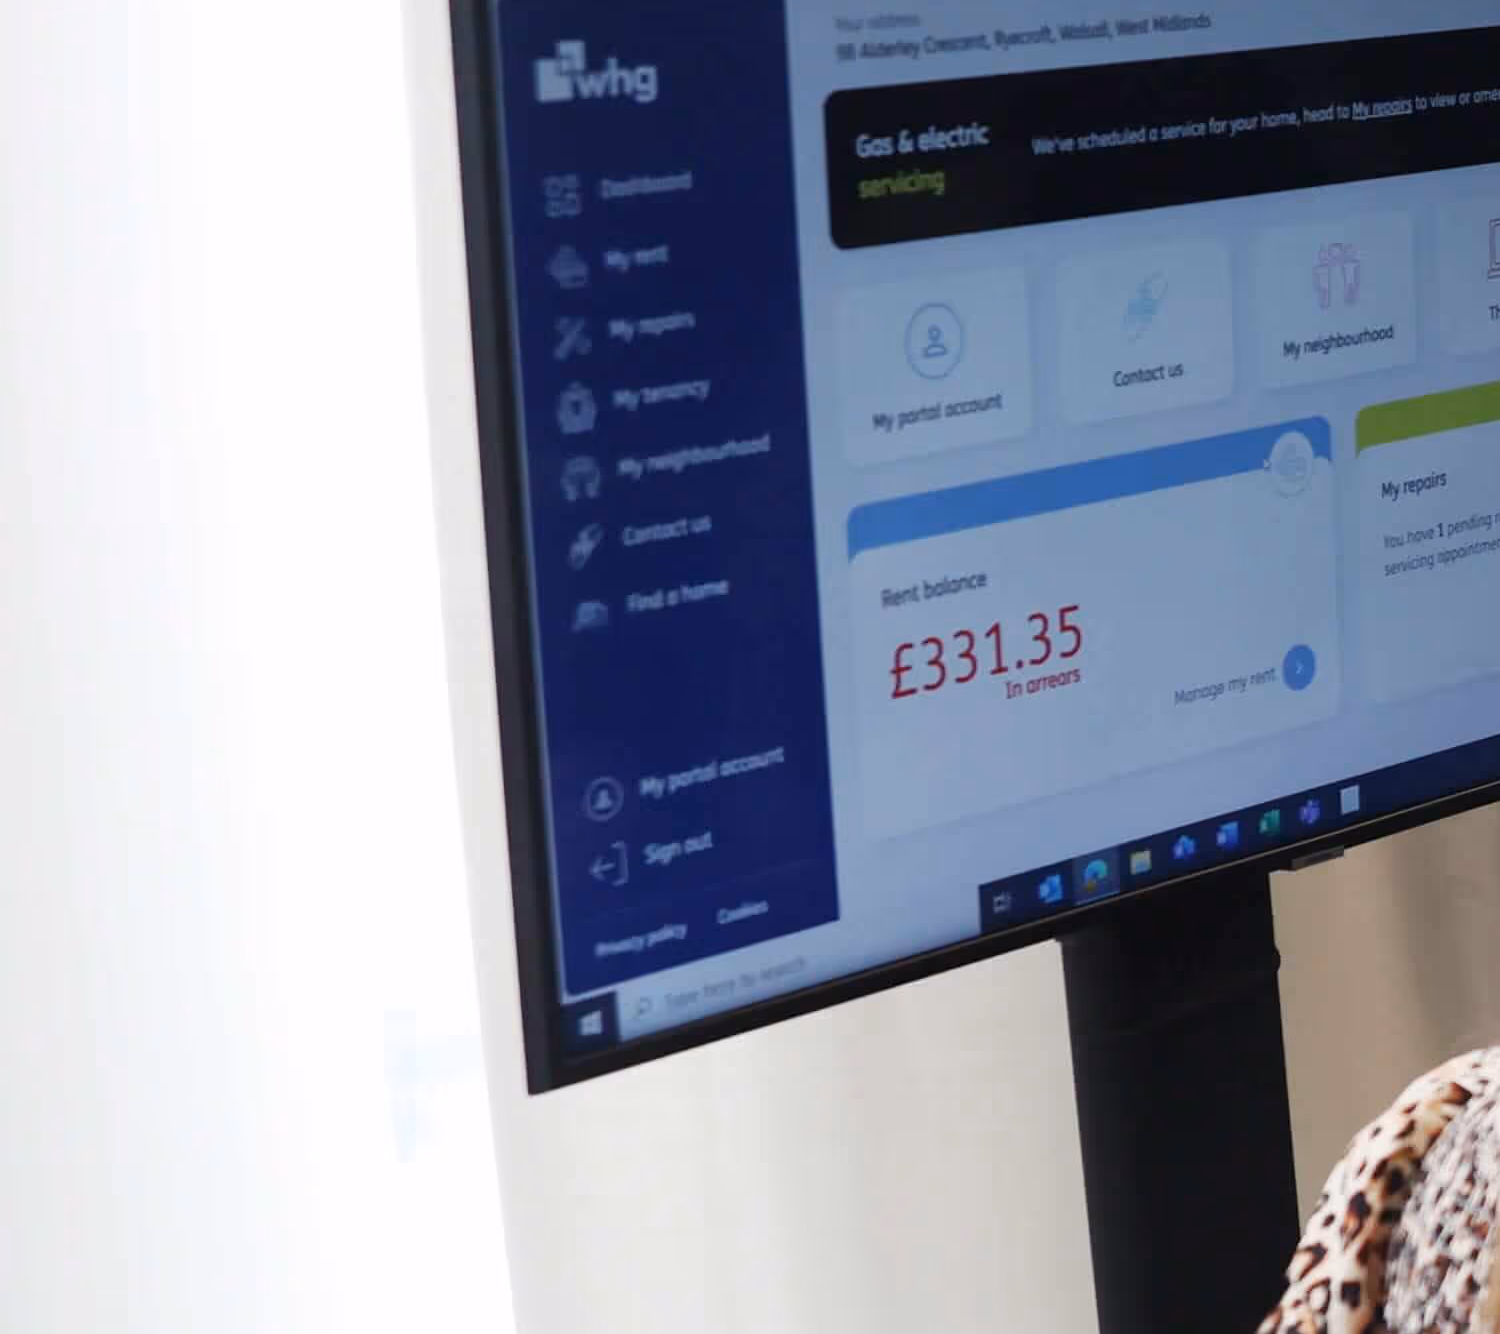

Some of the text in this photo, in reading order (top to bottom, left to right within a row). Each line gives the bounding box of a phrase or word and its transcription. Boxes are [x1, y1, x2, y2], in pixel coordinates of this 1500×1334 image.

[1077, 127, 1147, 149] scheduled
[1161, 121, 1207, 140] service
[1208, 117, 1227, 134] for
[1228, 116, 1260, 138] your
[1261, 111, 1301, 130] home,
[1303, 104, 1335, 125] head
[1336, 105, 1350, 120] to
[1352, 101, 1371, 121] My
[1372, 98, 1414, 118] repairs
[1415, 96, 1429, 111] to
[1430, 92, 1458, 109] view
[1459, 91, 1472, 106] or
[855, 122, 991, 159] Gas & electric
[858, 170, 945, 199] servicing
[608, 319, 635, 344] My
[1282, 323, 1395, 358] My neighbourhood
[1112, 362, 1185, 389] Contact us
[613, 389, 640, 411] My
[872, 392, 1004, 435] My portal account
[617, 458, 644, 481] My
[1382, 470, 1448, 502] My repairs
[622, 517, 688, 547] Contact
[1384, 534, 1405, 549] You
[1406, 527, 1435, 545] have
[1436, 522, 1445, 538] 1
[1446, 511, 1493, 538] pending
[1384, 552, 1435, 578] servicing
[880, 571, 988, 609] Rent balance
[889, 605, 1083, 700] £331.35
[1005, 667, 1082, 700] In arrears
[1173, 667, 1277, 706] Manage my rent
[640, 776, 666, 799] My
[644, 841, 682, 866] Sign
